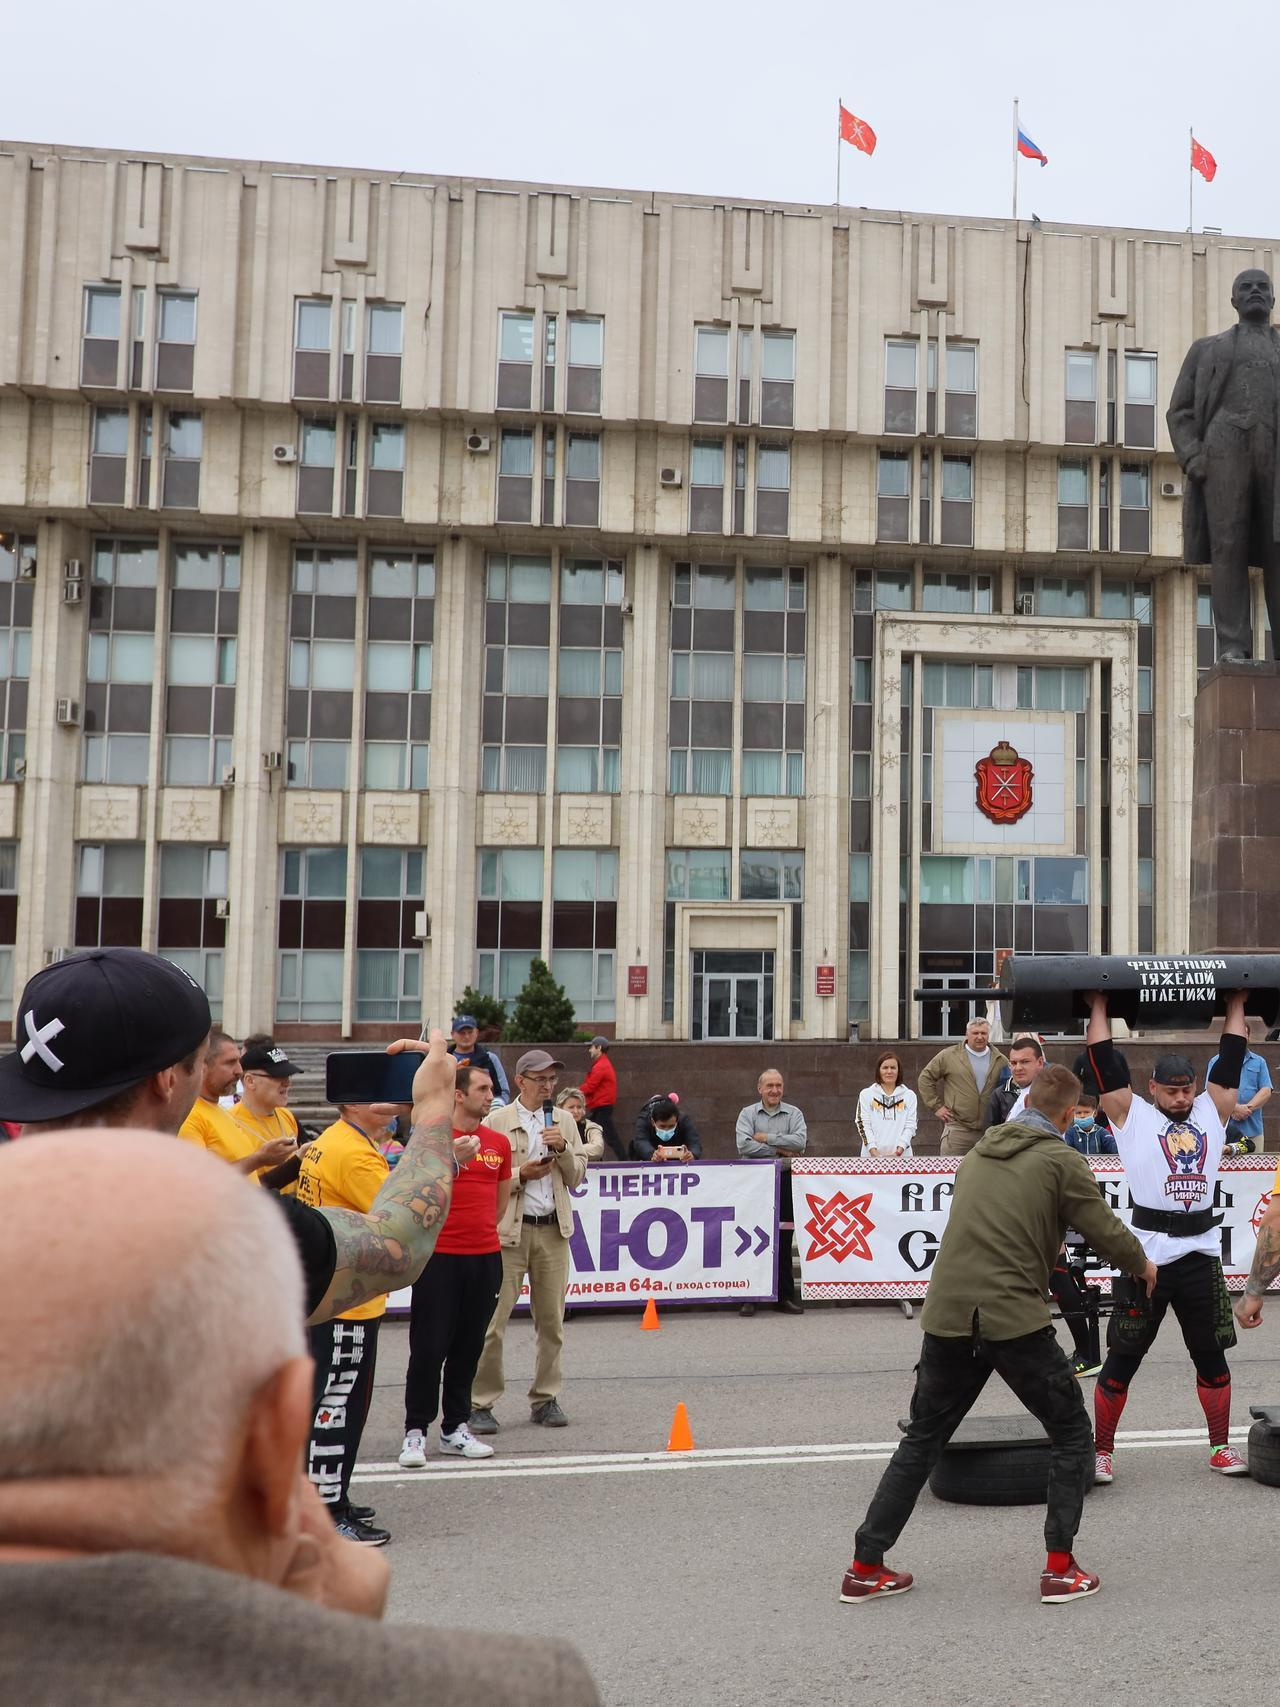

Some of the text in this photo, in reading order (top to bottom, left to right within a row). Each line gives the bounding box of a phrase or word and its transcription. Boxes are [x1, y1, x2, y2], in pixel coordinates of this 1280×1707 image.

[1127, 960, 1227, 970] ФЕДЕРАЦИЯ
[1140, 987, 1216, 1002] АТЛЕТИКИ
[599, 1172, 701, 1201] ЦЕНТР
[1165, 1180, 1208, 1194] НАЦИЯ
[1175, 1192, 1201, 1200] МИРА
[314, 1369, 359, 1429] BIG
